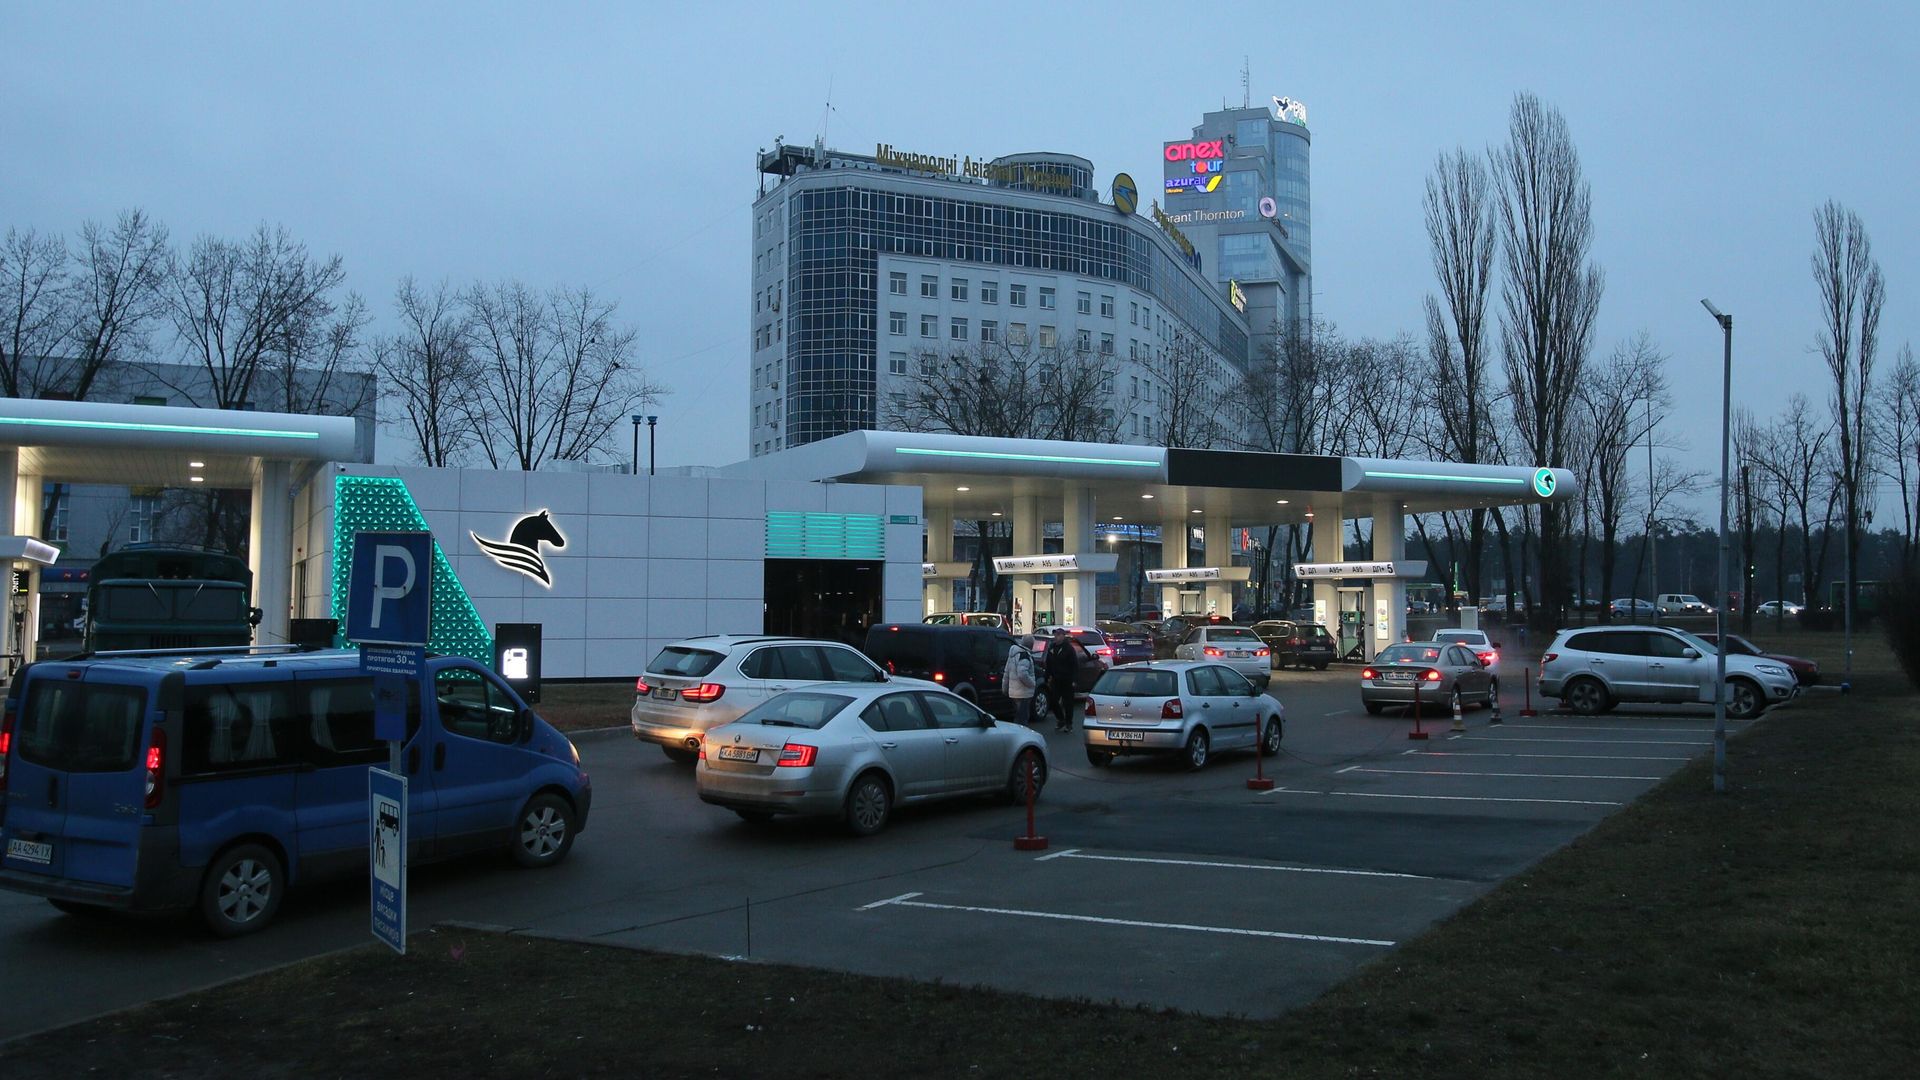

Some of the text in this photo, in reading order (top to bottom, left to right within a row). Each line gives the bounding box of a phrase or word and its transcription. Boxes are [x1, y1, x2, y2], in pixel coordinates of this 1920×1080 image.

[1165, 139, 1224, 161] anex
[877, 143, 957, 175] Міжнародні
[1190, 160, 1223, 174] tour
[1194, 209, 1245, 221] Thornton
[1299, 566, 1305, 575] 5
[1387, 564, 1393, 574] 5
[371, 545, 416, 629] P
[396, 654, 407, 664] 30
